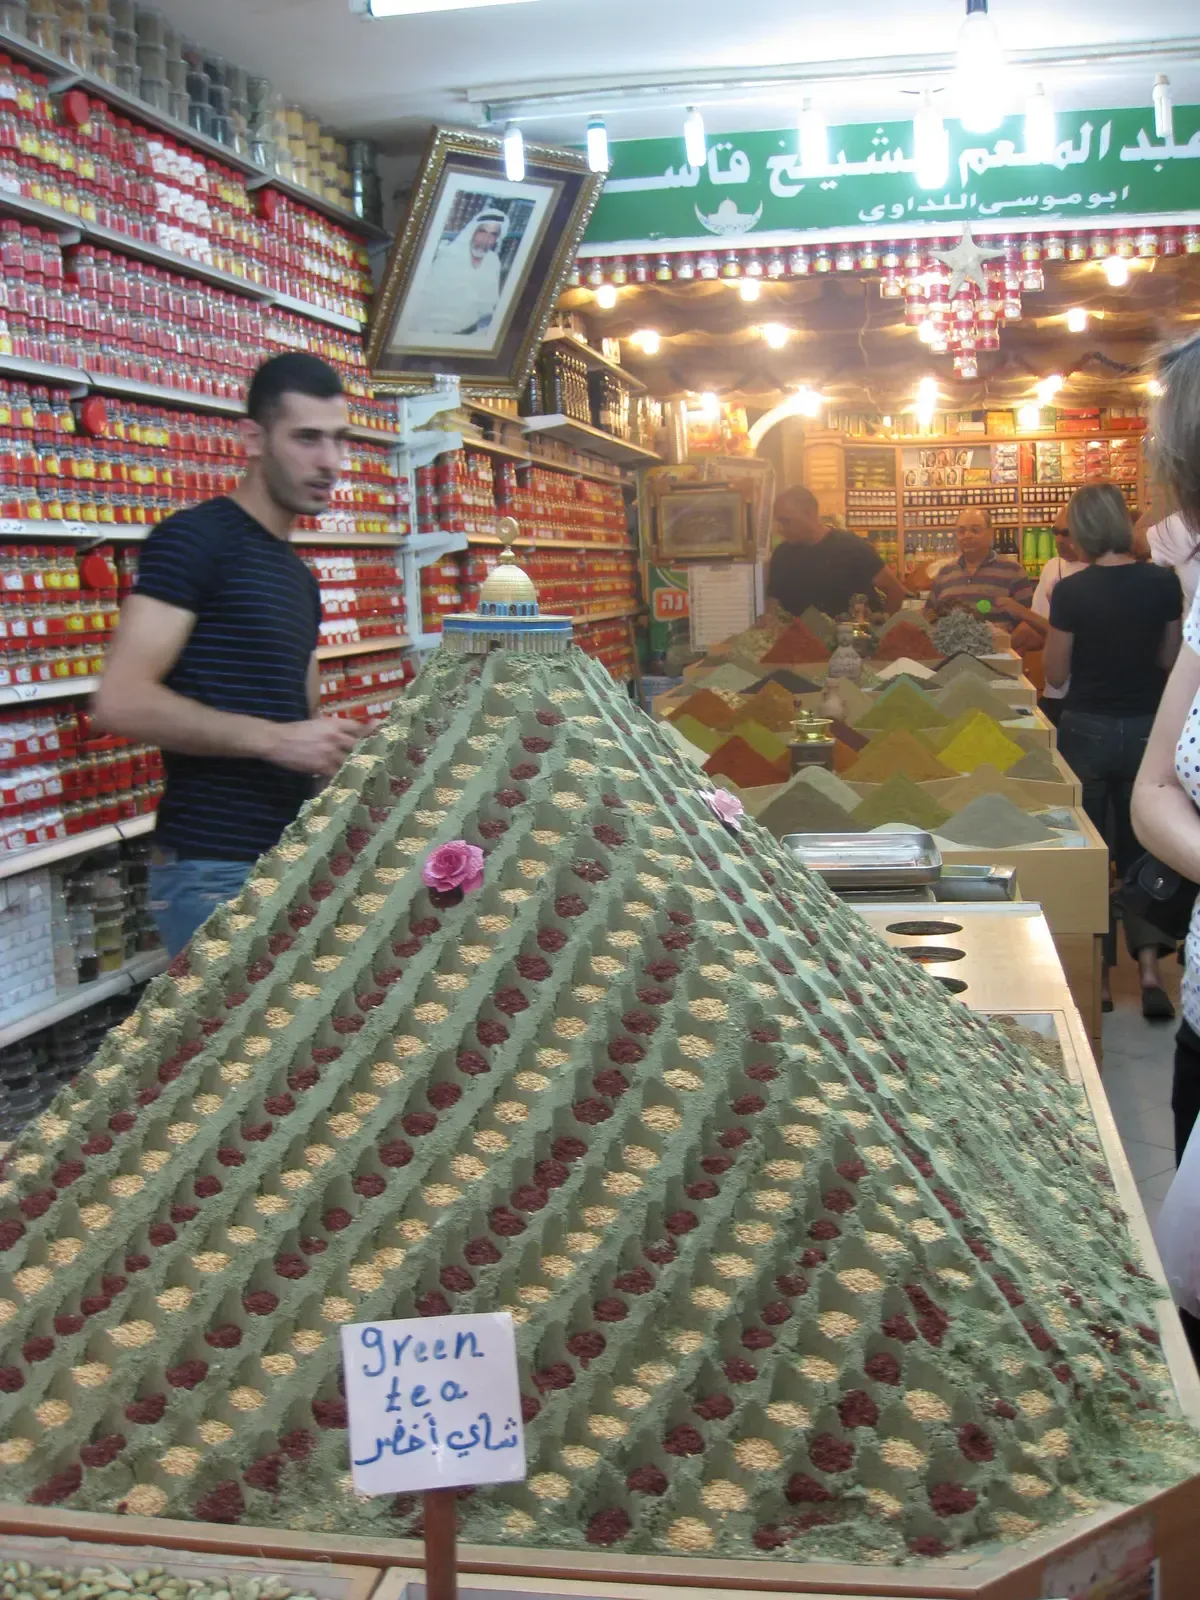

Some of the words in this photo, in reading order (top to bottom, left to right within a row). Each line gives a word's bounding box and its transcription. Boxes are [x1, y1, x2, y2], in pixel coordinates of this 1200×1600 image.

[959, 119, 1112, 189] المعم
[361, 1326, 485, 1378] green
[385, 1376, 469, 1413] tea
[353, 1411, 440, 1466] أخضر
[446, 1411, 519, 1458] شاي
